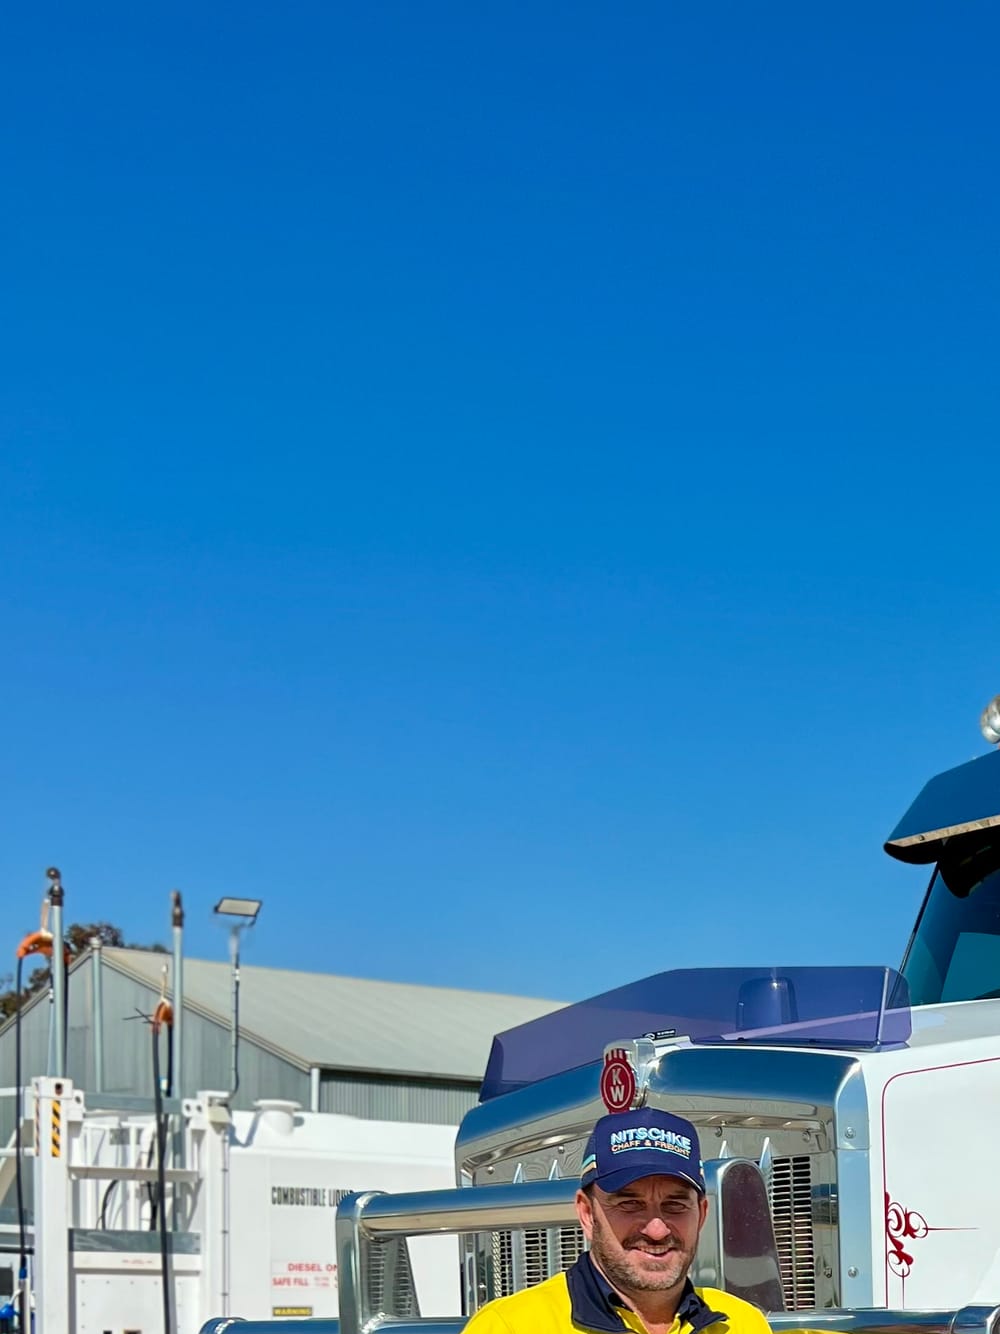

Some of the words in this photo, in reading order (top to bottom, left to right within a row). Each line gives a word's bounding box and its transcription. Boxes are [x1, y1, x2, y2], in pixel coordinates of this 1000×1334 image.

[610, 1127, 691, 1150] NITSCHKE
[611, 1140, 640, 1152] CHAFF
[644, 1139, 651, 1147] &
[654, 1141, 690, 1156] FREIGHT
[271, 1186, 326, 1207] COMBUSTIBLE
[287, 1263, 322, 1272] DIESEL
